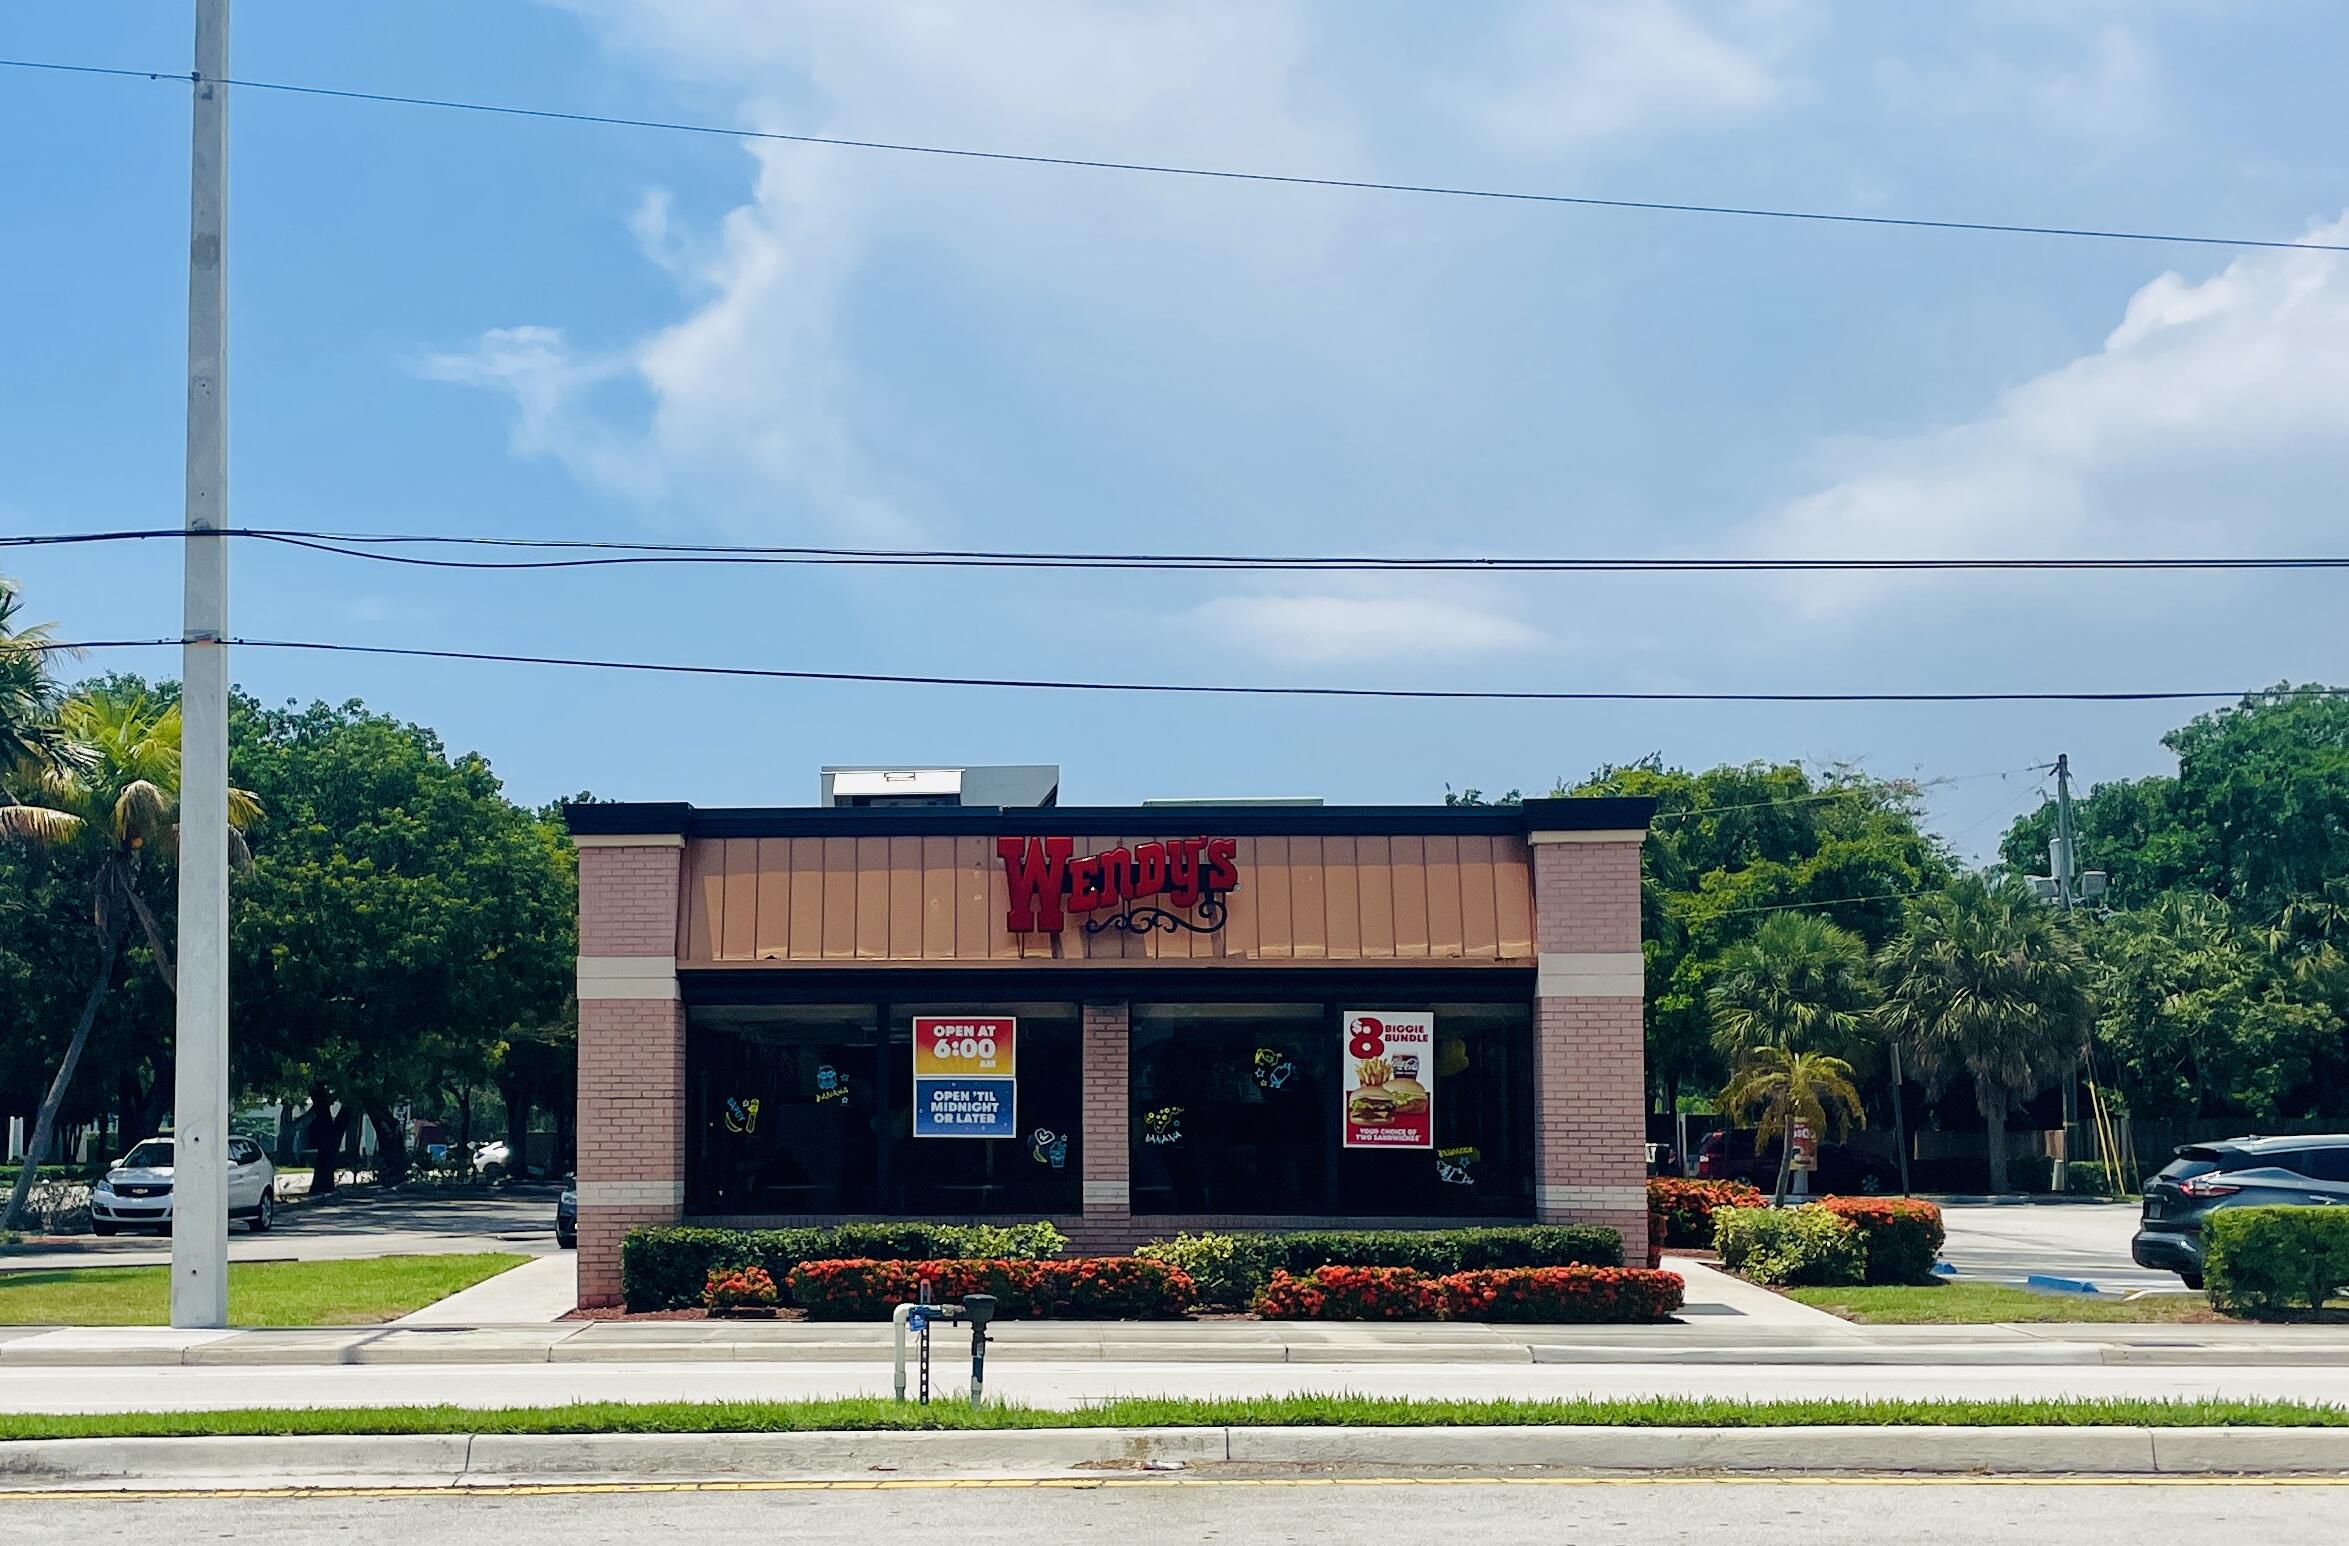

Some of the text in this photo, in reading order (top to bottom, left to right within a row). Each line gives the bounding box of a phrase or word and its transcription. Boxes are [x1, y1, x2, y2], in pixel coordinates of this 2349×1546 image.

[933, 1025, 996, 1037] OPEN AT
[1385, 1024, 1425, 1033] BIGGIE
[1385, 1033, 1429, 1042] BUNDLE
[933, 1038, 996, 1059] 6:00
[980, 1060, 996, 1068] AM
[934, 1091, 996, 1101] OPEN 'TIL
[931, 1102, 999, 1112] MIDNIGHT
[934, 1113, 995, 1123] OR LATER
